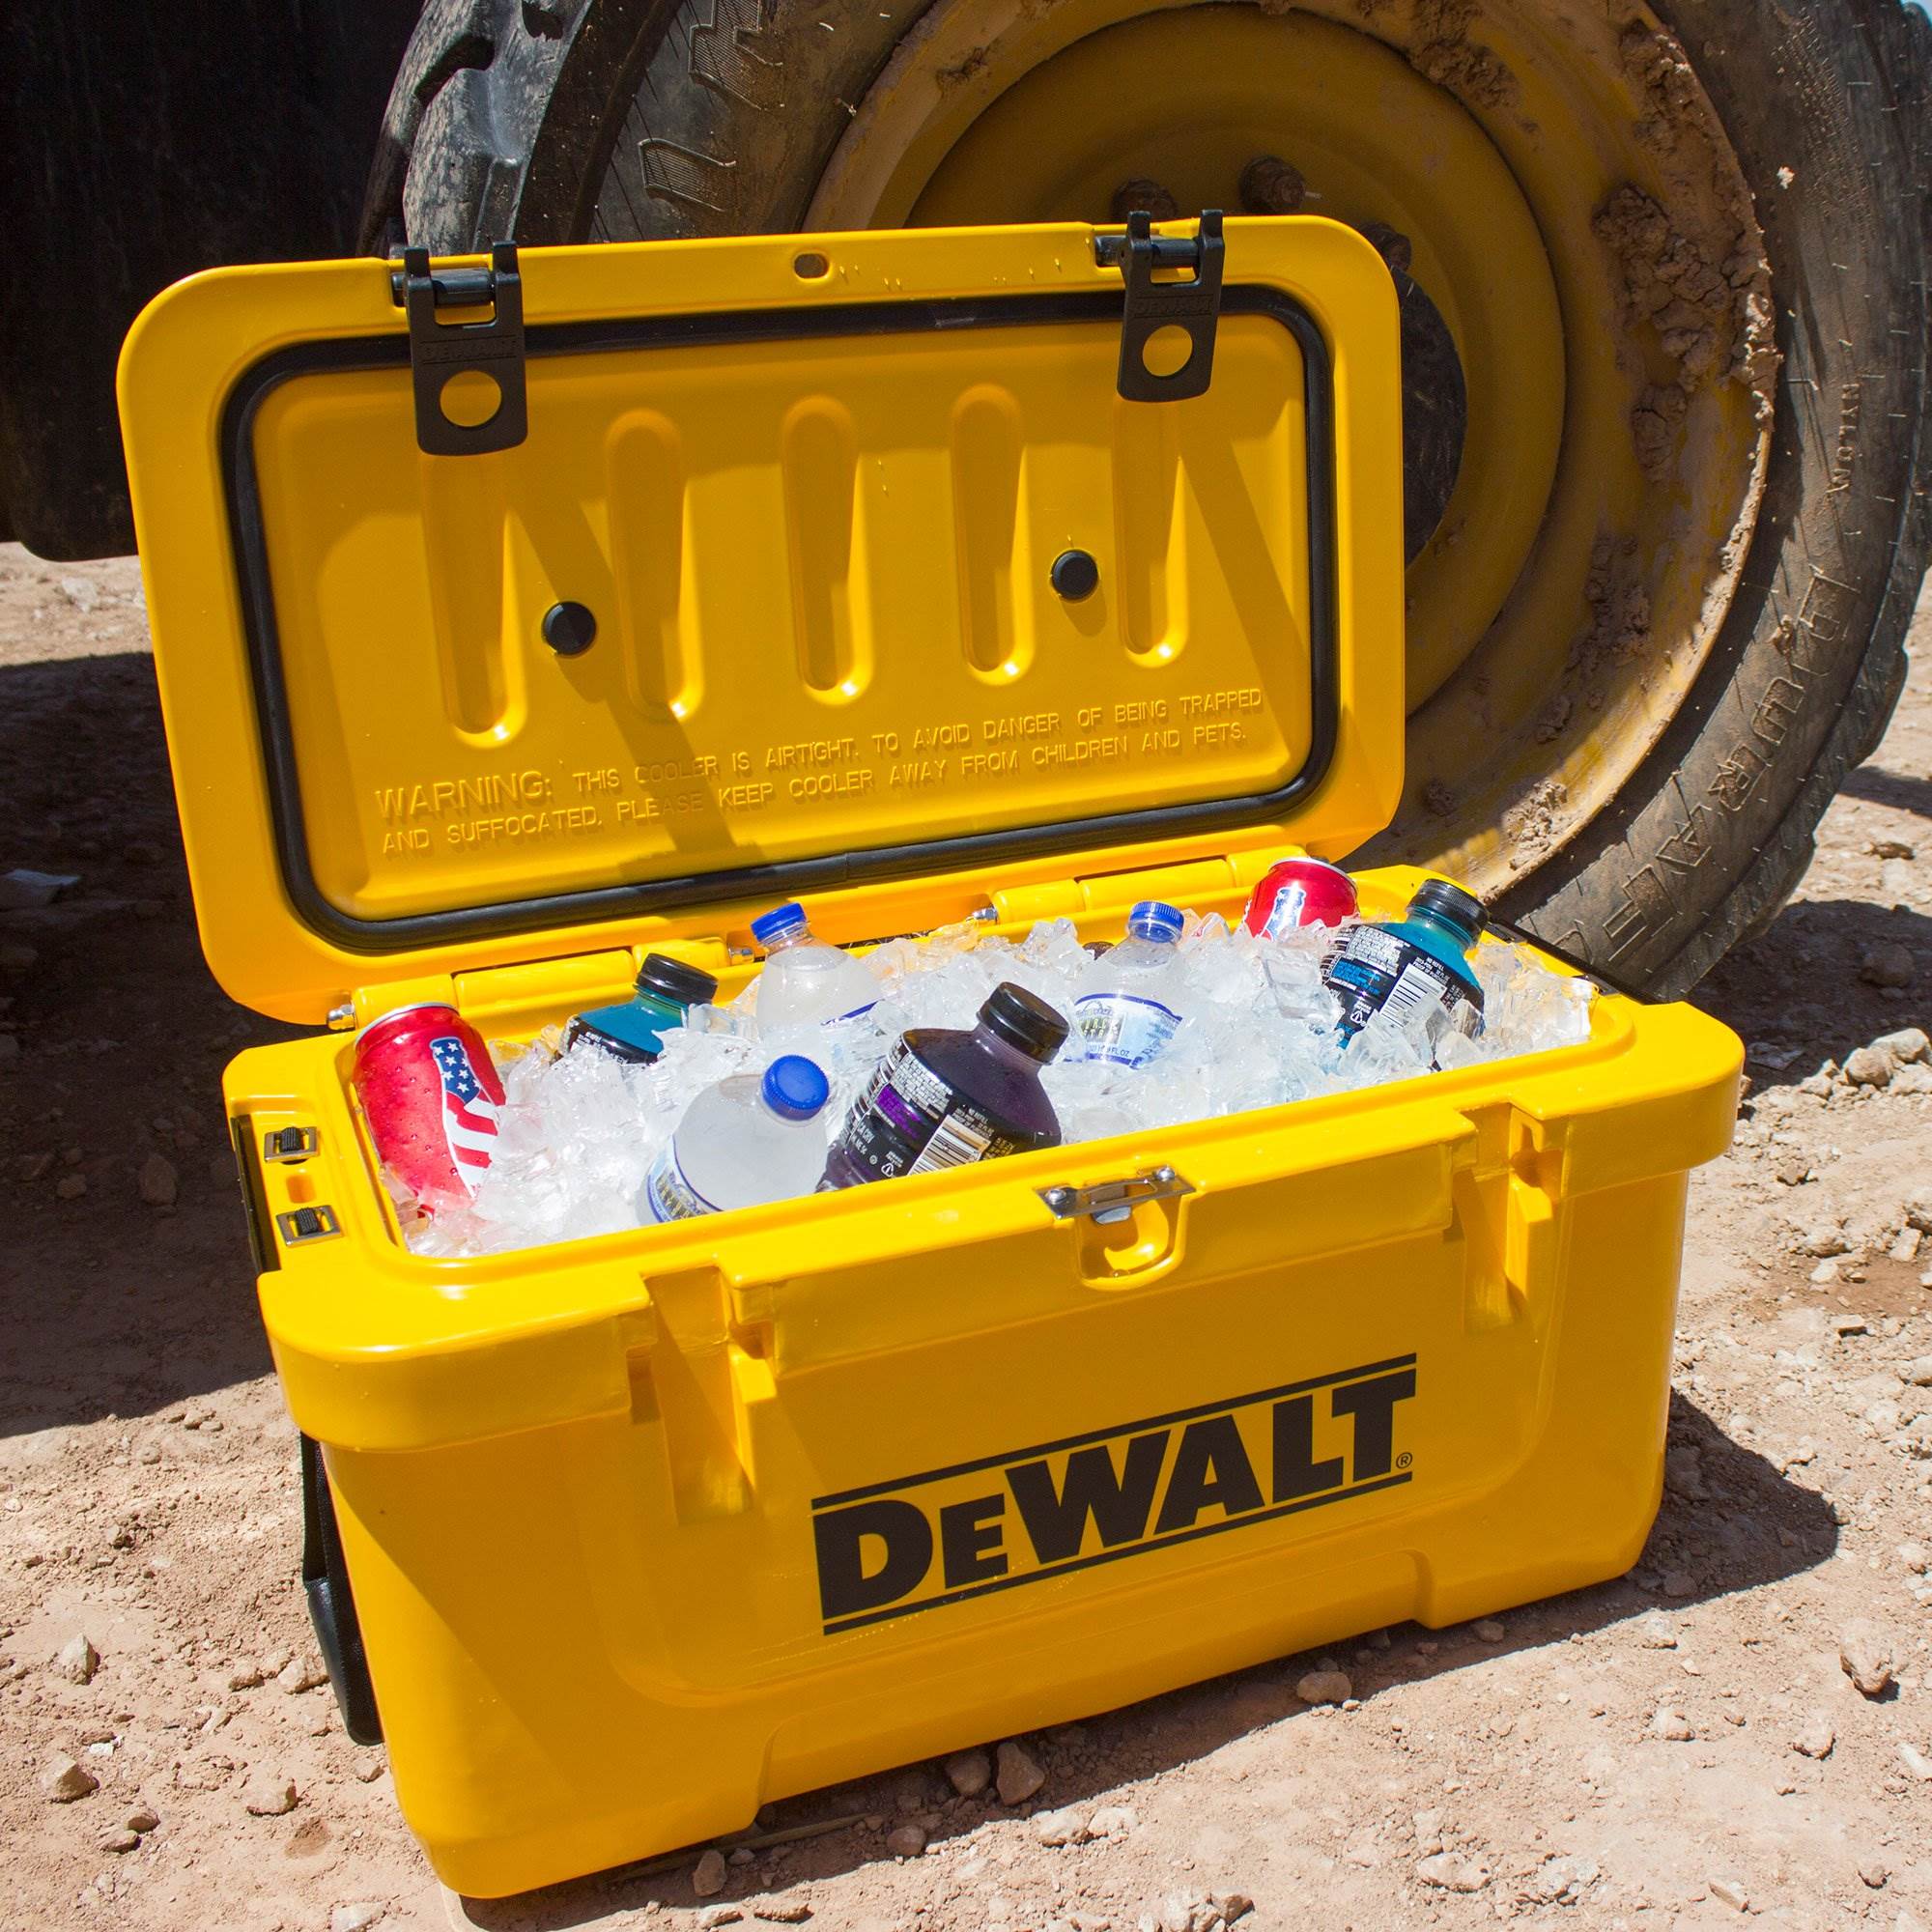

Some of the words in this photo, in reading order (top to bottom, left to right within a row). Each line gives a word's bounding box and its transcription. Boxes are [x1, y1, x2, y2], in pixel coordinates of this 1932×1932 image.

[374, 770, 553, 819] WARNING:
[571, 768, 620, 793] THIS
[634, 755, 719, 784] COOLER
[731, 752, 751, 772] IS
[765, 737, 859, 768] AIRTIGHT.
[871, 731, 899, 753] TO
[913, 724, 971, 750] AVOID
[983, 712, 1060, 740] DANGER
[1077, 707, 1102, 727] OF
[1114, 699, 1168, 724] BEING
[1179, 688, 1262, 716] TRAPPED
[383, 828, 430, 854] AND
[616, 793, 704, 822] PLEASE
[718, 782, 774, 808] KEEP
[788, 769, 873, 797] COOLER
[889, 759, 947, 785] AWAY
[961, 750, 1018, 776] FROM
[1032, 735, 1128, 765] CHILDREN
[1142, 729, 1180, 753] AND
[1193, 722, 1246, 745] PETS.
